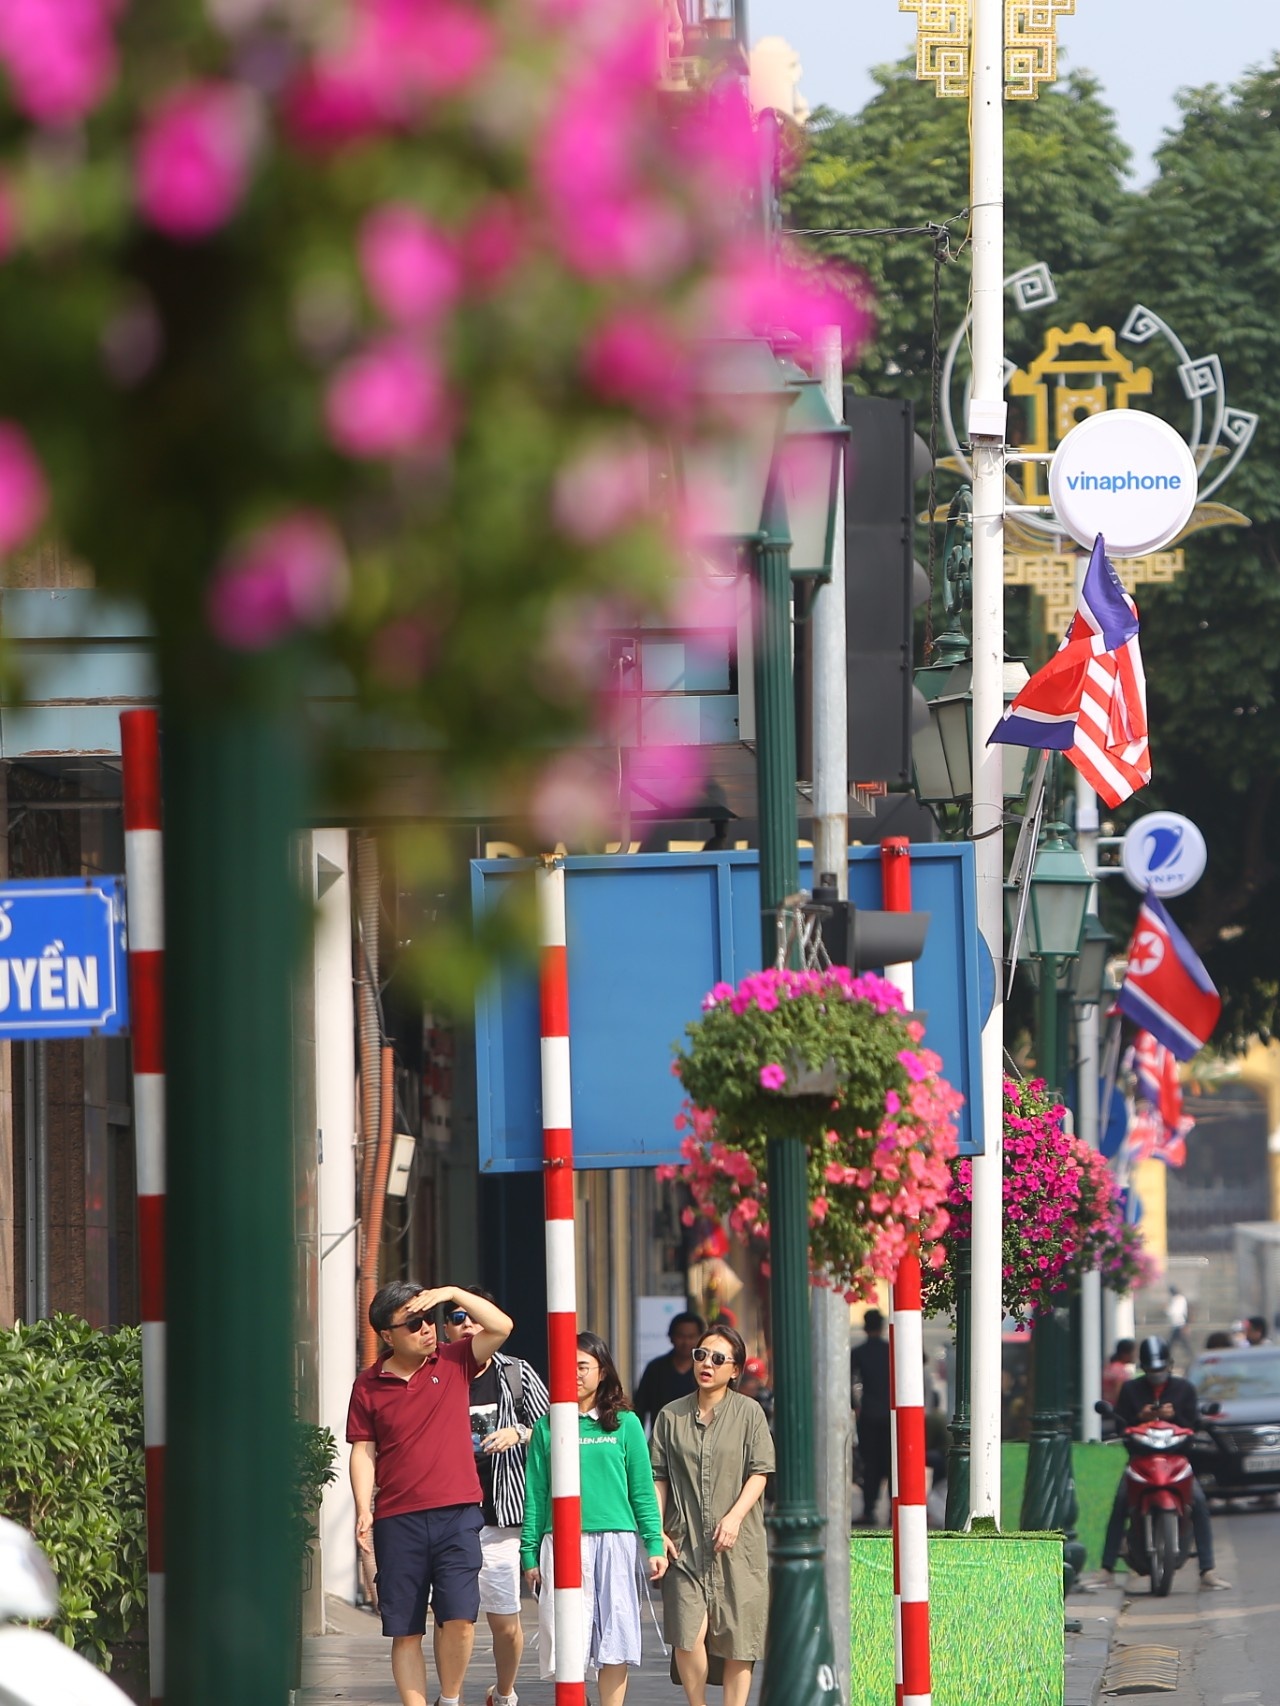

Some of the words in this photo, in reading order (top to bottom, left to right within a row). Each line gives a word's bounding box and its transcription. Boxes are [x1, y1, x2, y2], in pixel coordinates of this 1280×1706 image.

[1066, 471, 1181, 493] vinaphone
[1144, 873, 1185, 883] VNPT
[594, 1435, 617, 1445] JEANS
